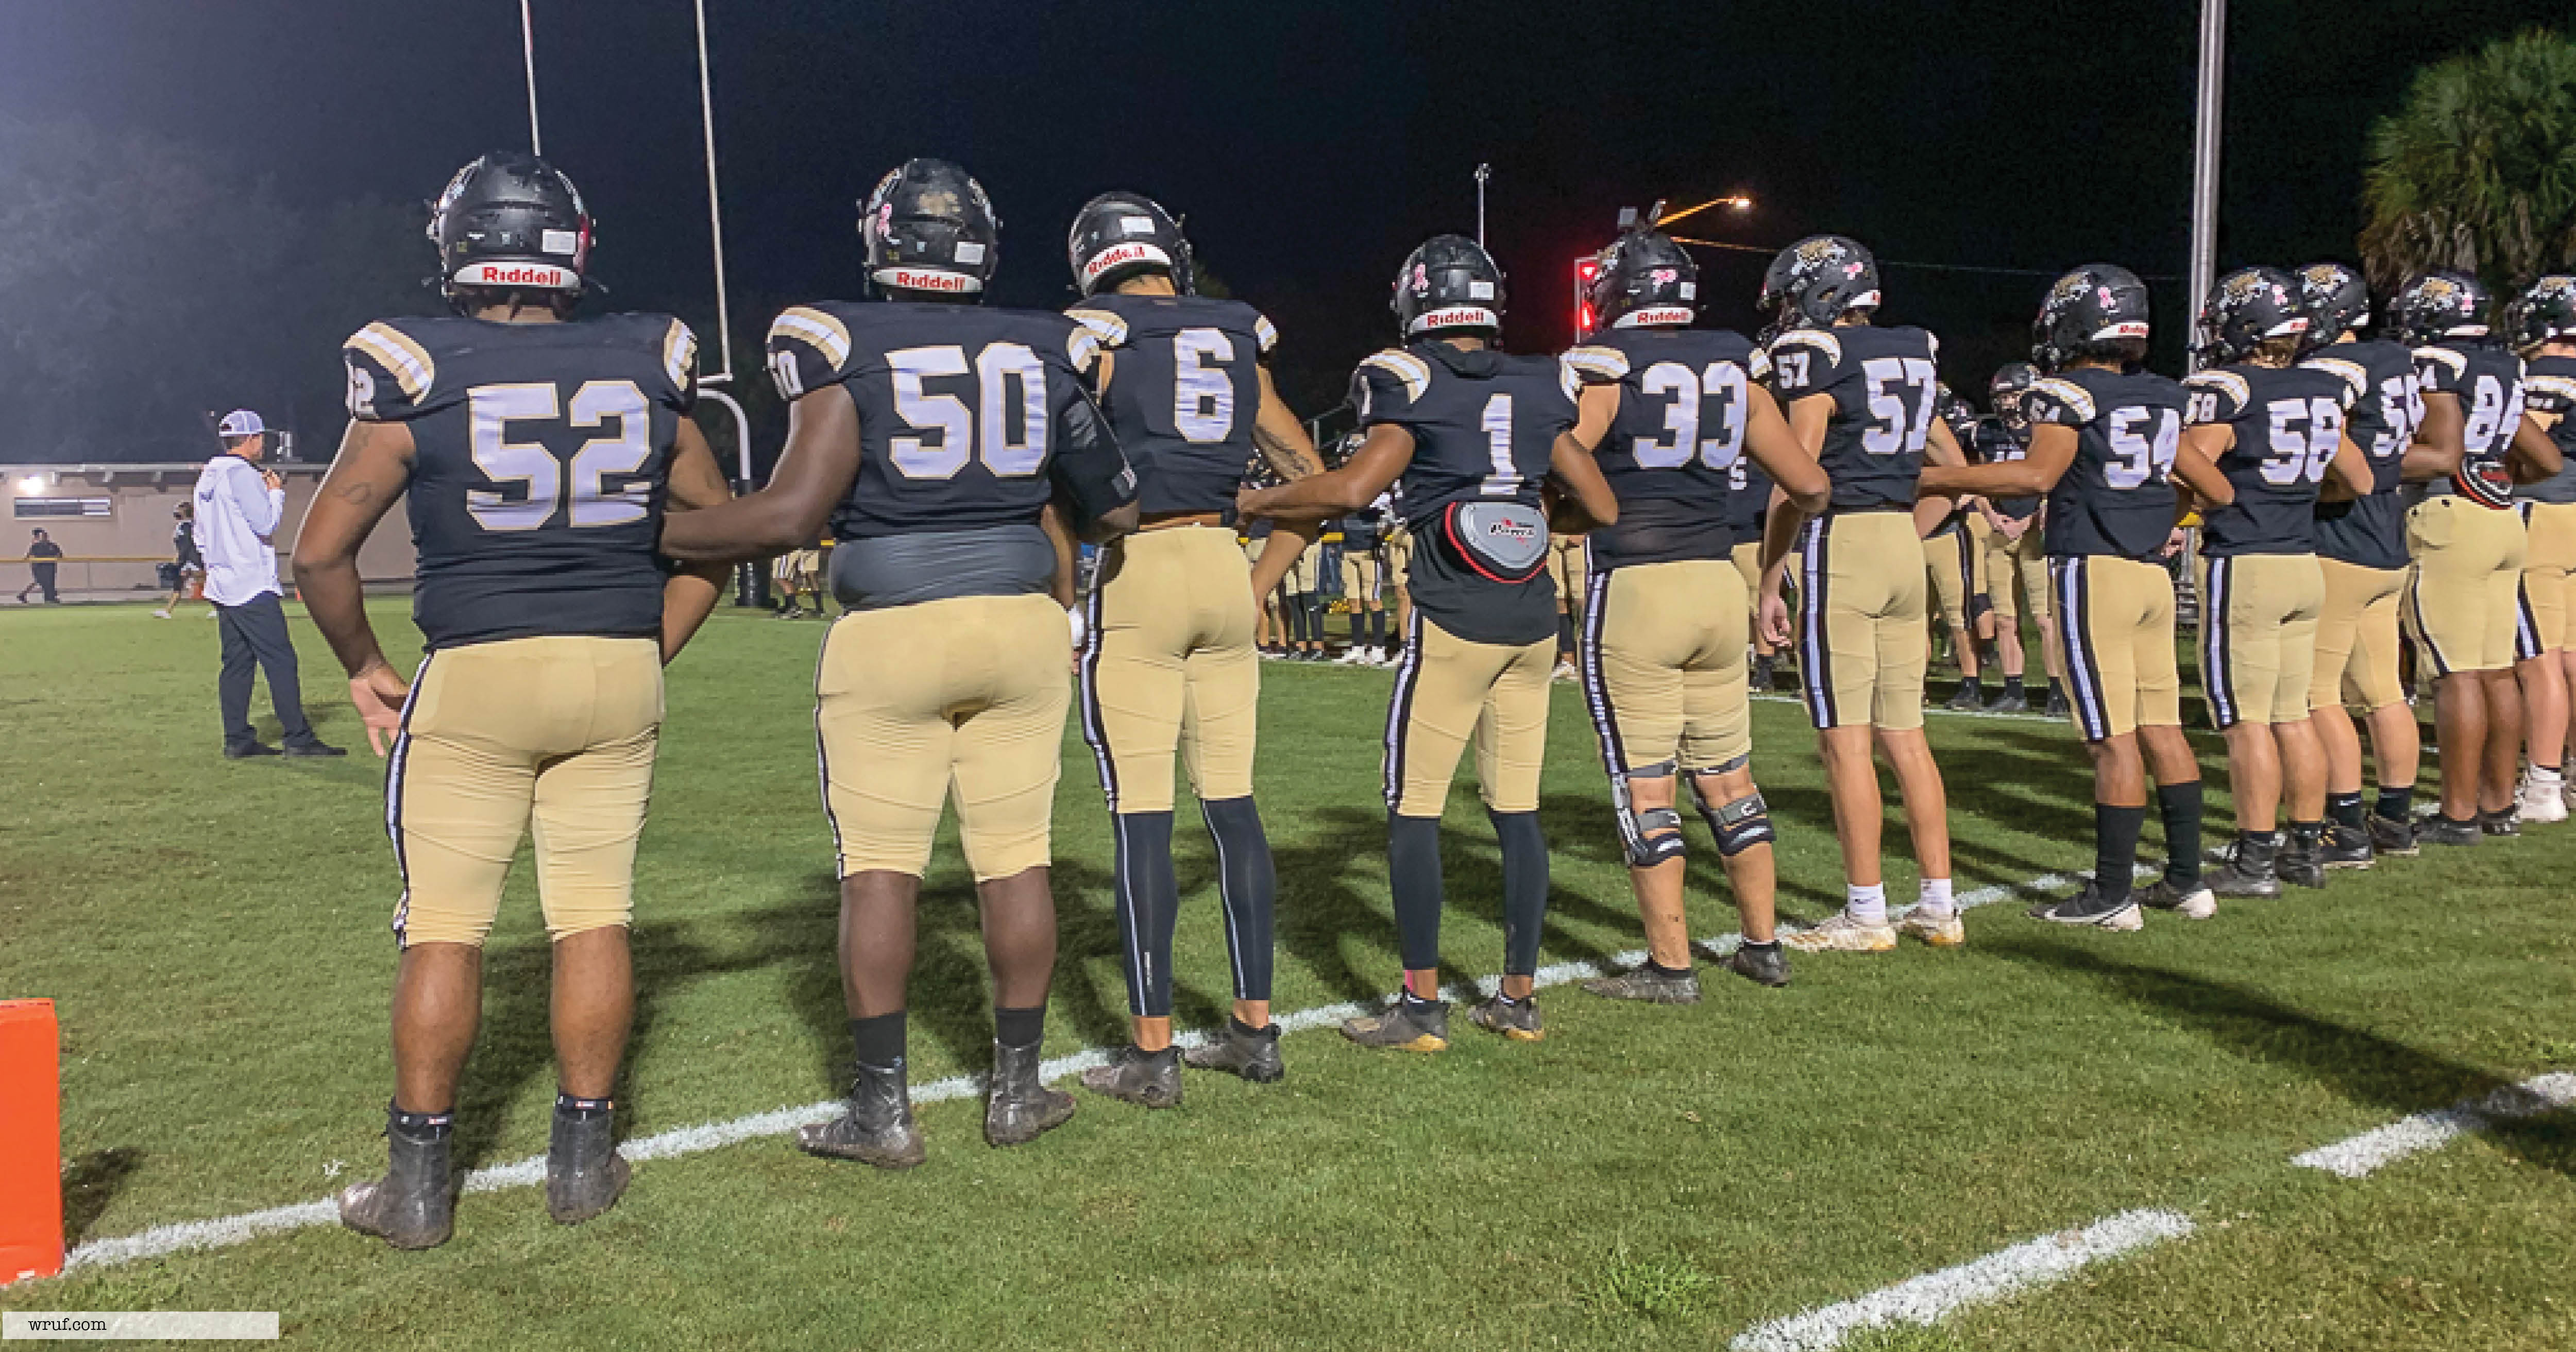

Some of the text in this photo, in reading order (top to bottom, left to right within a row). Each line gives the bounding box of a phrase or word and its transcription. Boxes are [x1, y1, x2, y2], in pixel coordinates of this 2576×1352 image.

[482, 267, 561, 285] Riddell
[896, 271, 965, 292] Riddell
[1428, 310, 1484, 327] Riddell
[884, 341, 1048, 480] 50
[1174, 327, 1235, 442] 6
[1633, 360, 1748, 470] 33
[1776, 351, 1810, 389] 57
[1862, 357, 1936, 454] 57
[467, 381, 651, 530] 52
[1481, 393, 1524, 495] 1
[2260, 396, 2341, 485] 58
